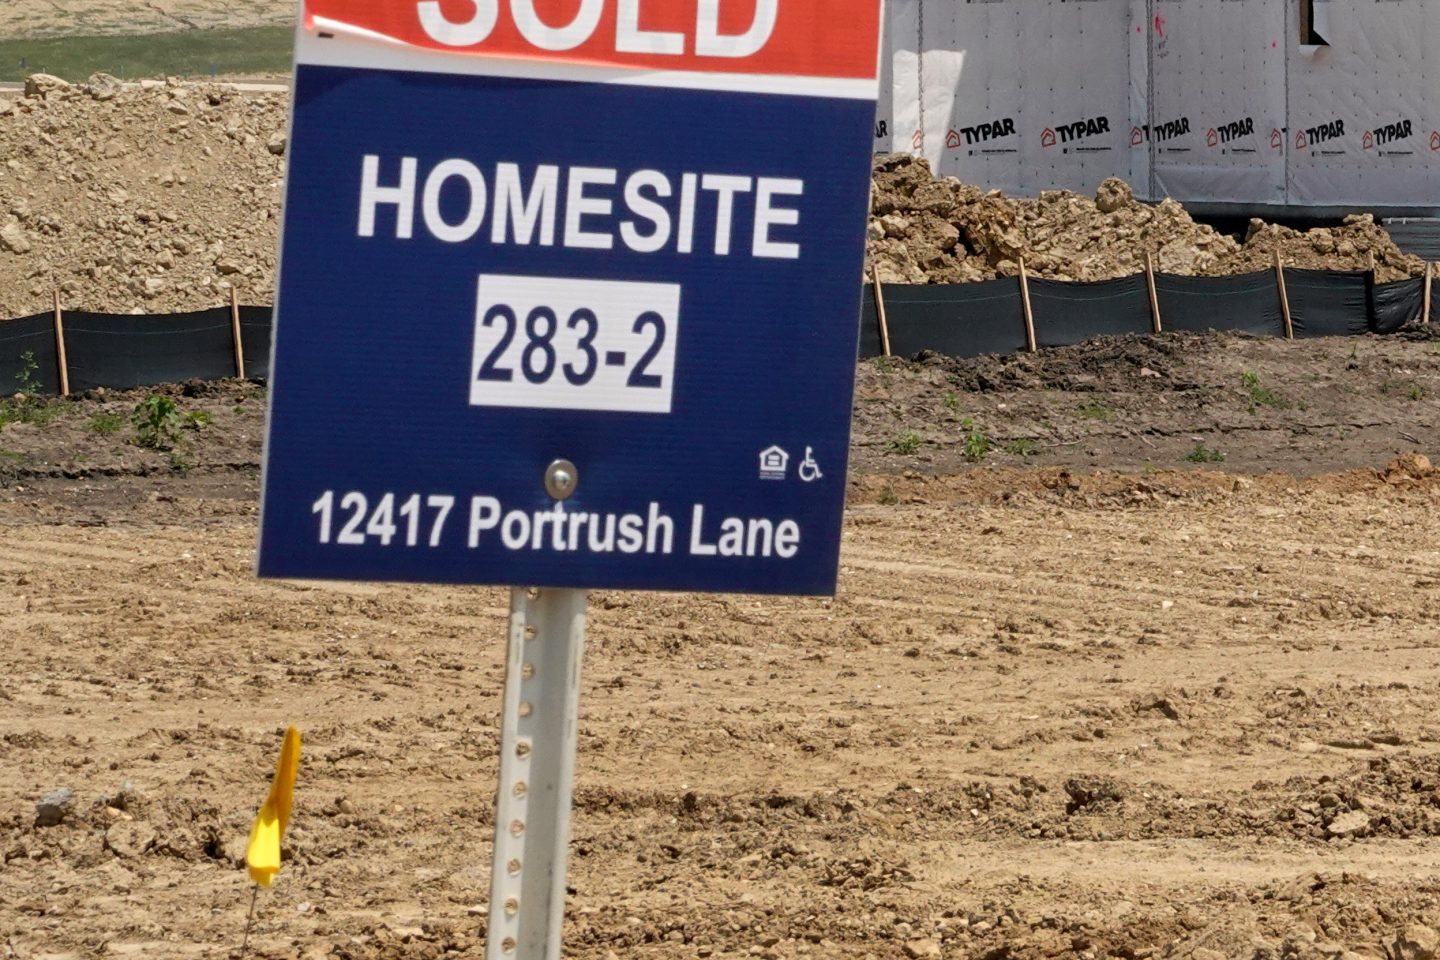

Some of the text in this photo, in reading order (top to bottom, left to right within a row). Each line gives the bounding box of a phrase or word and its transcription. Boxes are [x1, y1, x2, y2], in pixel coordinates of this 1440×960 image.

[960, 118, 1016, 144] TYPAR
[1055, 116, 1110, 143] TYPAR
[1154, 117, 1190, 142] TYPAR
[1217, 117, 1254, 142] TYPAR
[1305, 119, 1345, 145] TYPAR
[1373, 119, 1413, 145] TYPAR
[356, 154, 803, 260] HOMESITE
[478, 302, 667, 390] 283-2
[311, 490, 801, 558] 12417 Portrush Lane
